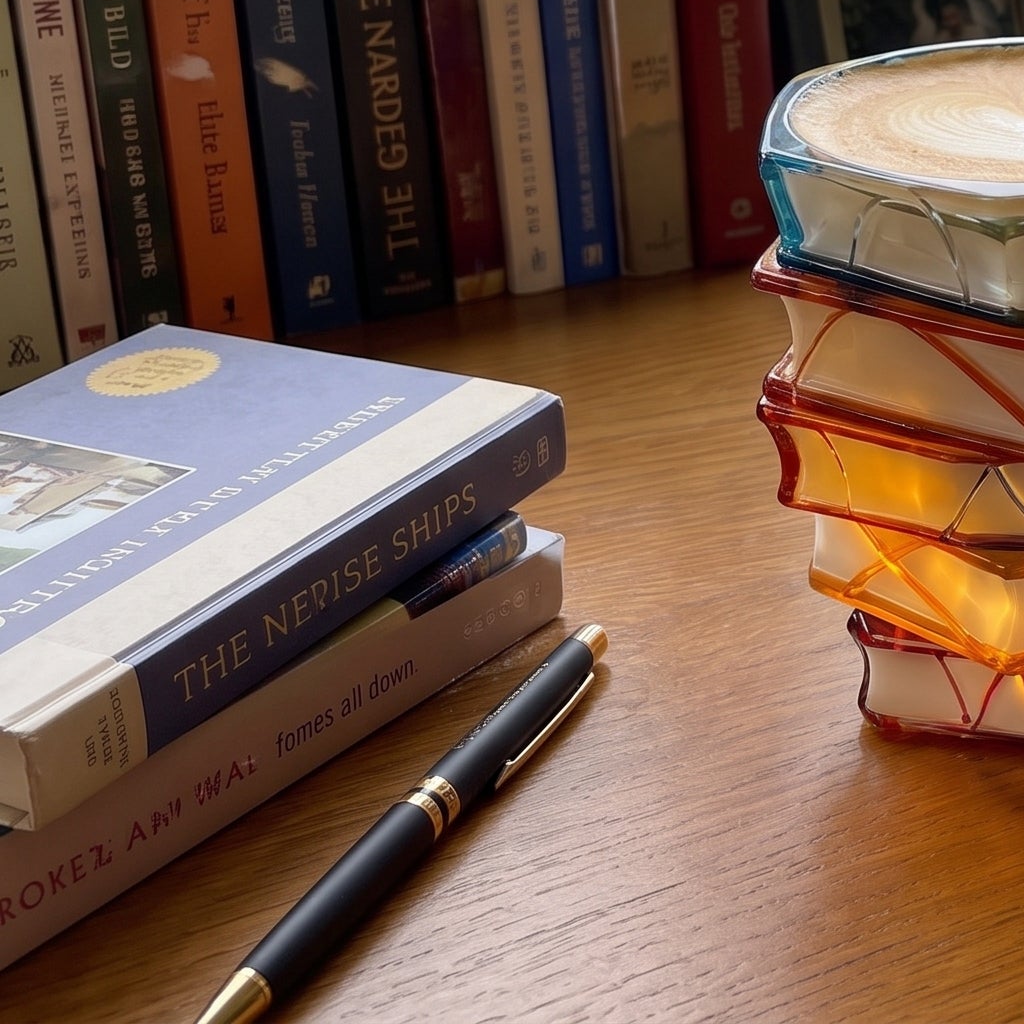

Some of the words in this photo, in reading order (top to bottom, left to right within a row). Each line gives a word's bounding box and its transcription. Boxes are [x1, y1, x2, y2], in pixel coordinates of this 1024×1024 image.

[173, 629, 252, 703] THE
[390, 482, 477, 561] SHIPS
[275, 708, 334, 758] fomes
[341, 684, 362, 718] all
[369, 659, 418, 700] down.
